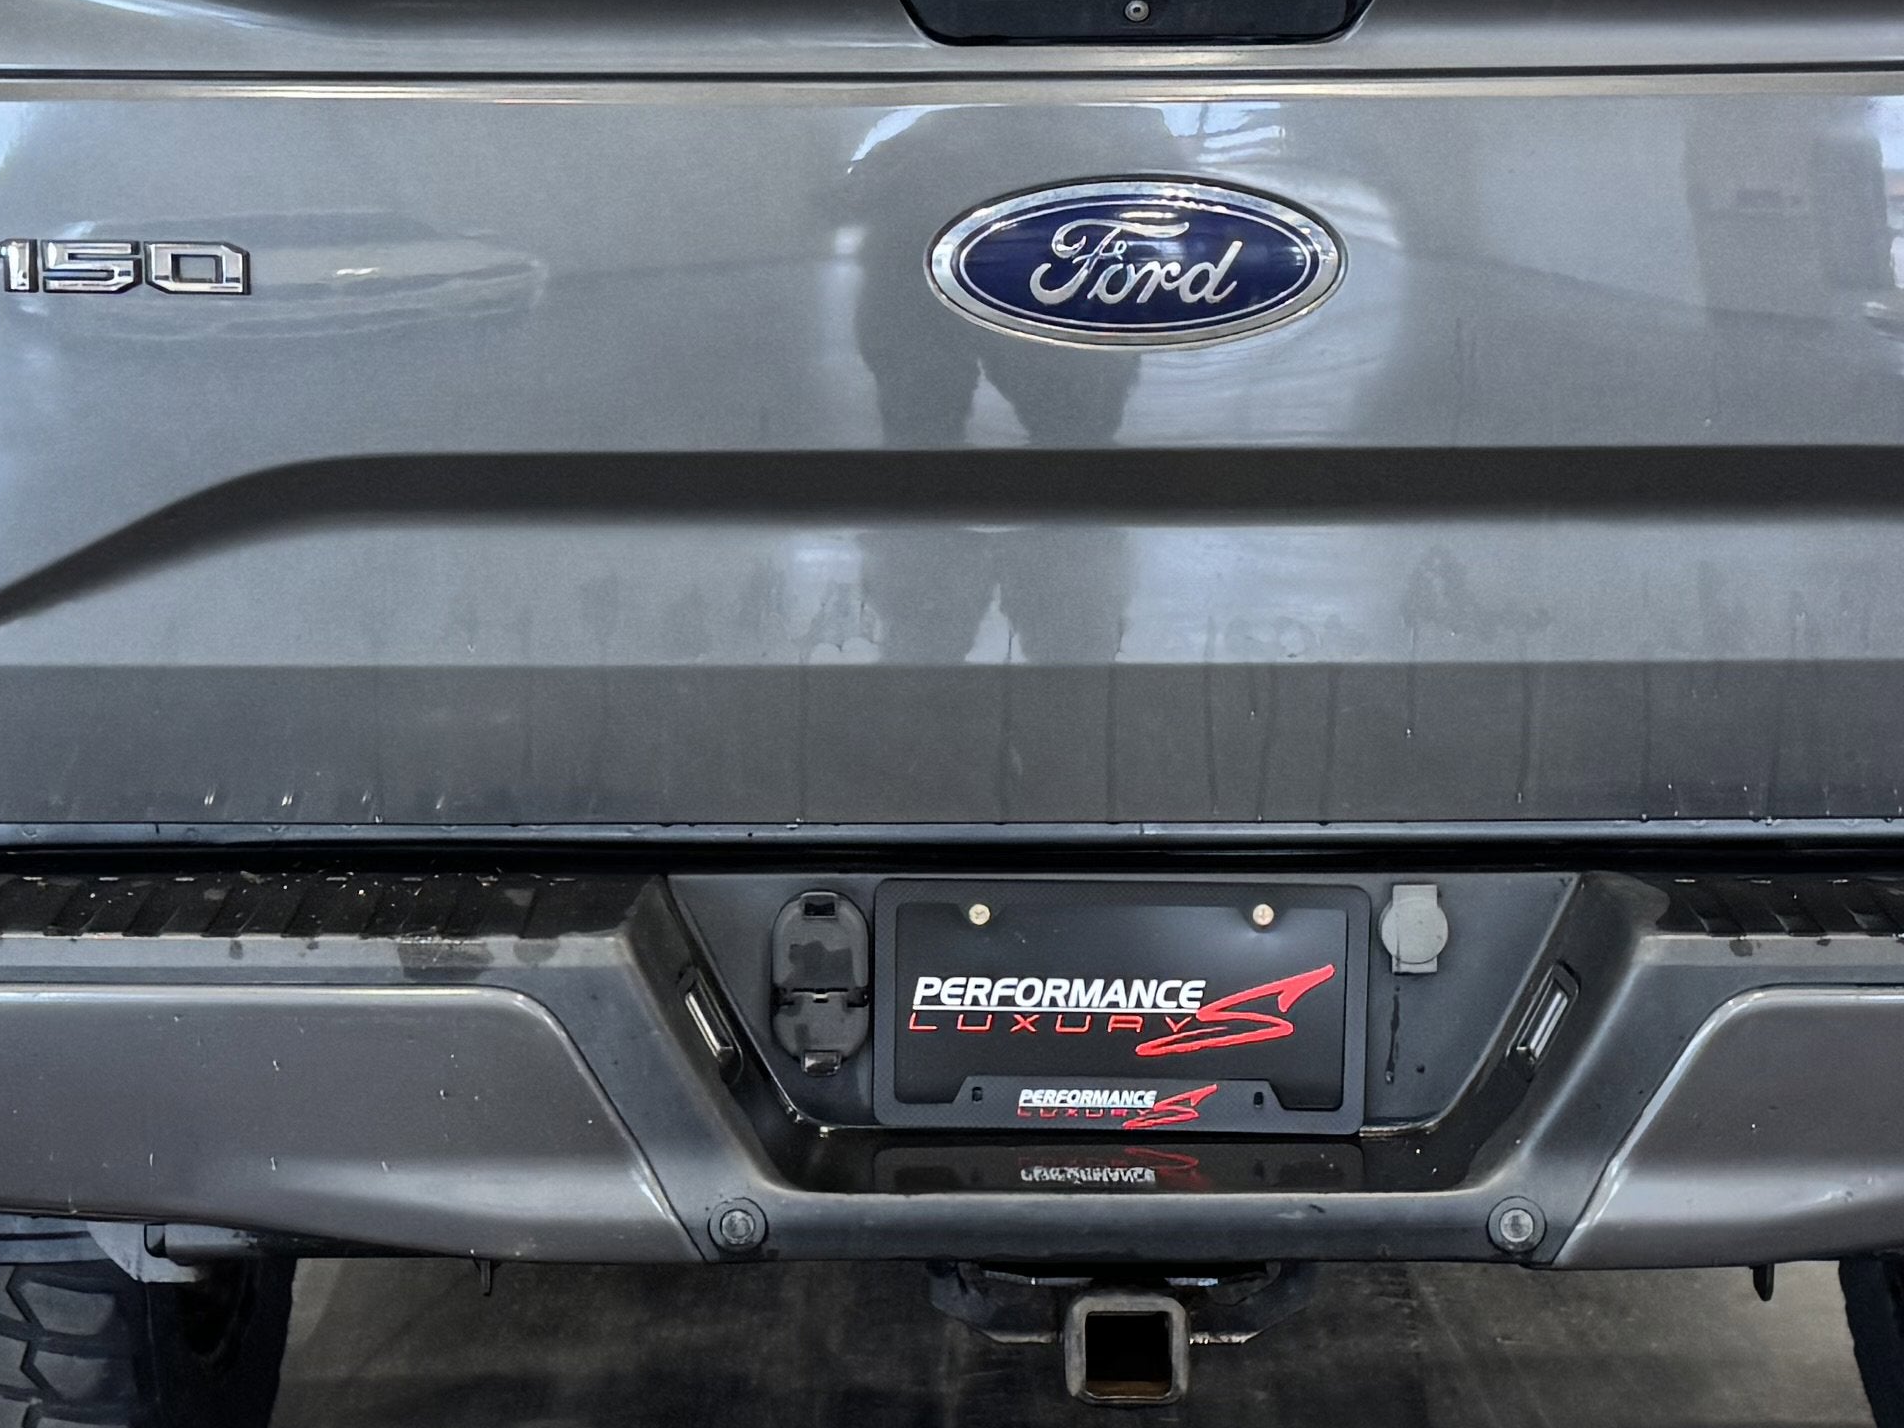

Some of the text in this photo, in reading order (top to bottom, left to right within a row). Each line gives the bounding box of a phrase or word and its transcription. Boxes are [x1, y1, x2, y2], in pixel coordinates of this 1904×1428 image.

[1030, 217, 1243, 306] Ford
[912, 976, 1207, 1010] PERFORMANCE
[908, 1012, 1193, 1033] LUXURY
[1018, 1088, 1158, 1107] PERFORMANCE
